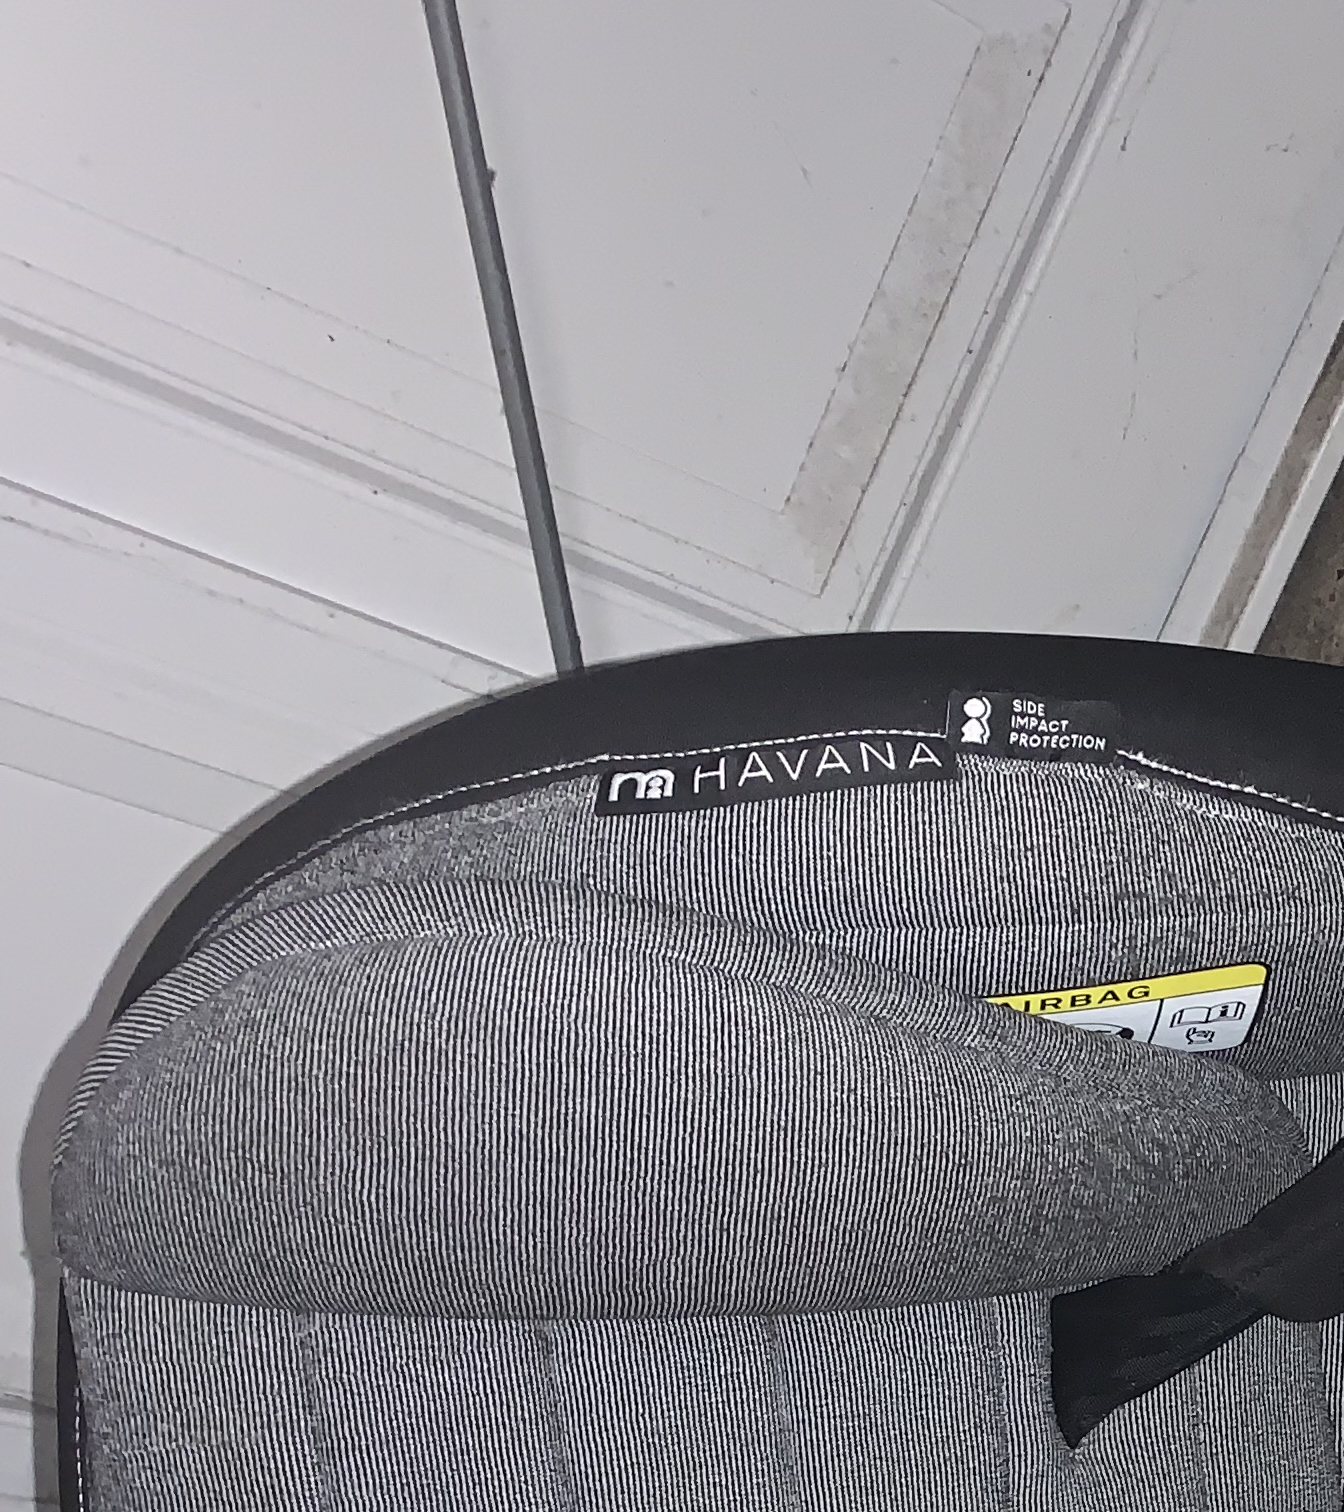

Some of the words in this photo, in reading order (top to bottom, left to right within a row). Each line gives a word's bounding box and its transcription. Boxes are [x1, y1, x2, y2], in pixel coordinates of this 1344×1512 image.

[1012, 698, 1046, 717] SIDE
[1010, 714, 1070, 733] IMPACT
[1008, 731, 1107, 751] PROTECTION
[693, 740, 943, 794] HAVANA
